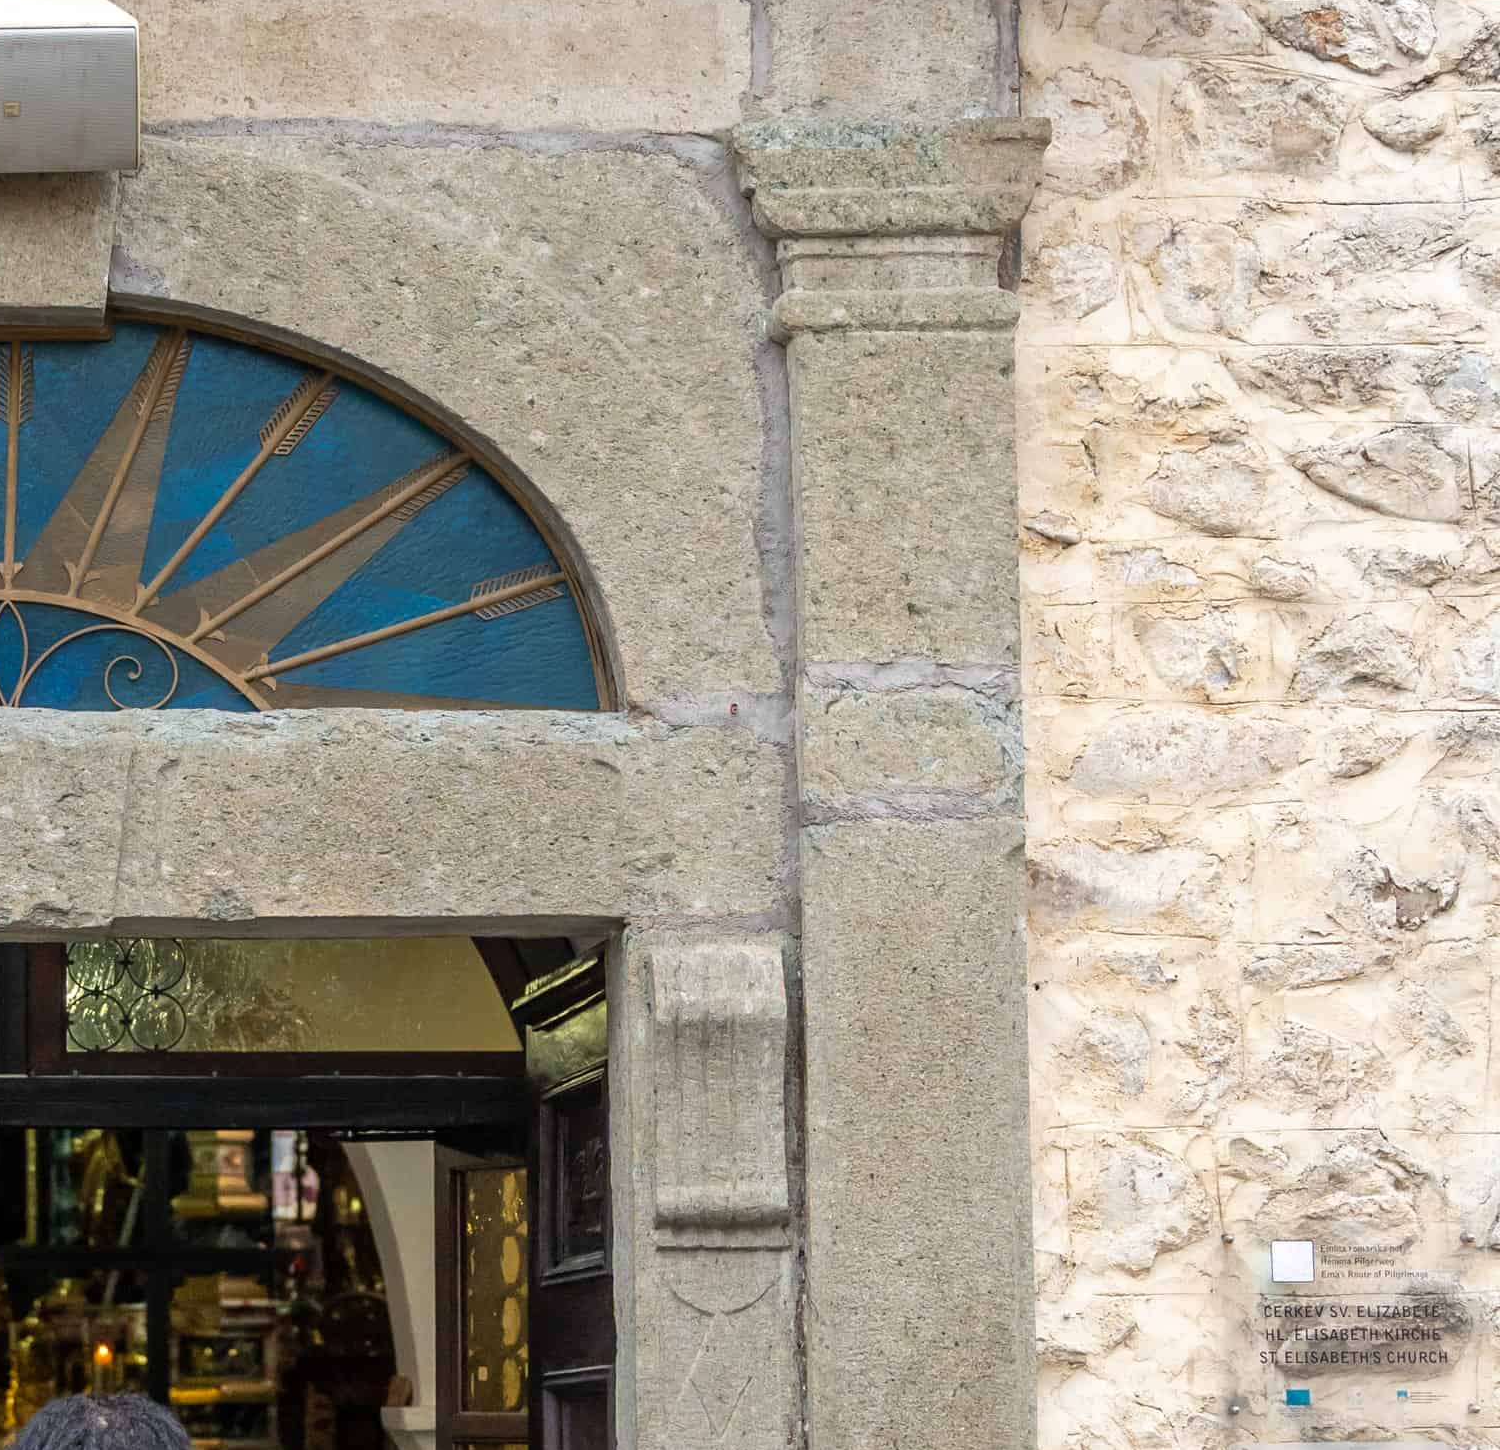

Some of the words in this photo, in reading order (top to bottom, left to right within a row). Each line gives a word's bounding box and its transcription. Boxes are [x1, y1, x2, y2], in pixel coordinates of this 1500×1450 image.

[1264, 1305, 1324, 1318] CERKEV
[1330, 1305, 1350, 1318] SV.
[1357, 1305, 1440, 1318] ELIZABETE
[1266, 1328, 1289, 1341] HL.
[1295, 1328, 1380, 1341] ELISABETH
[1385, 1328, 1443, 1341] KIRCHE
[1285, 1351, 1381, 1364] ELISABETH'S
[1387, 1351, 1448, 1364] CHURCH
